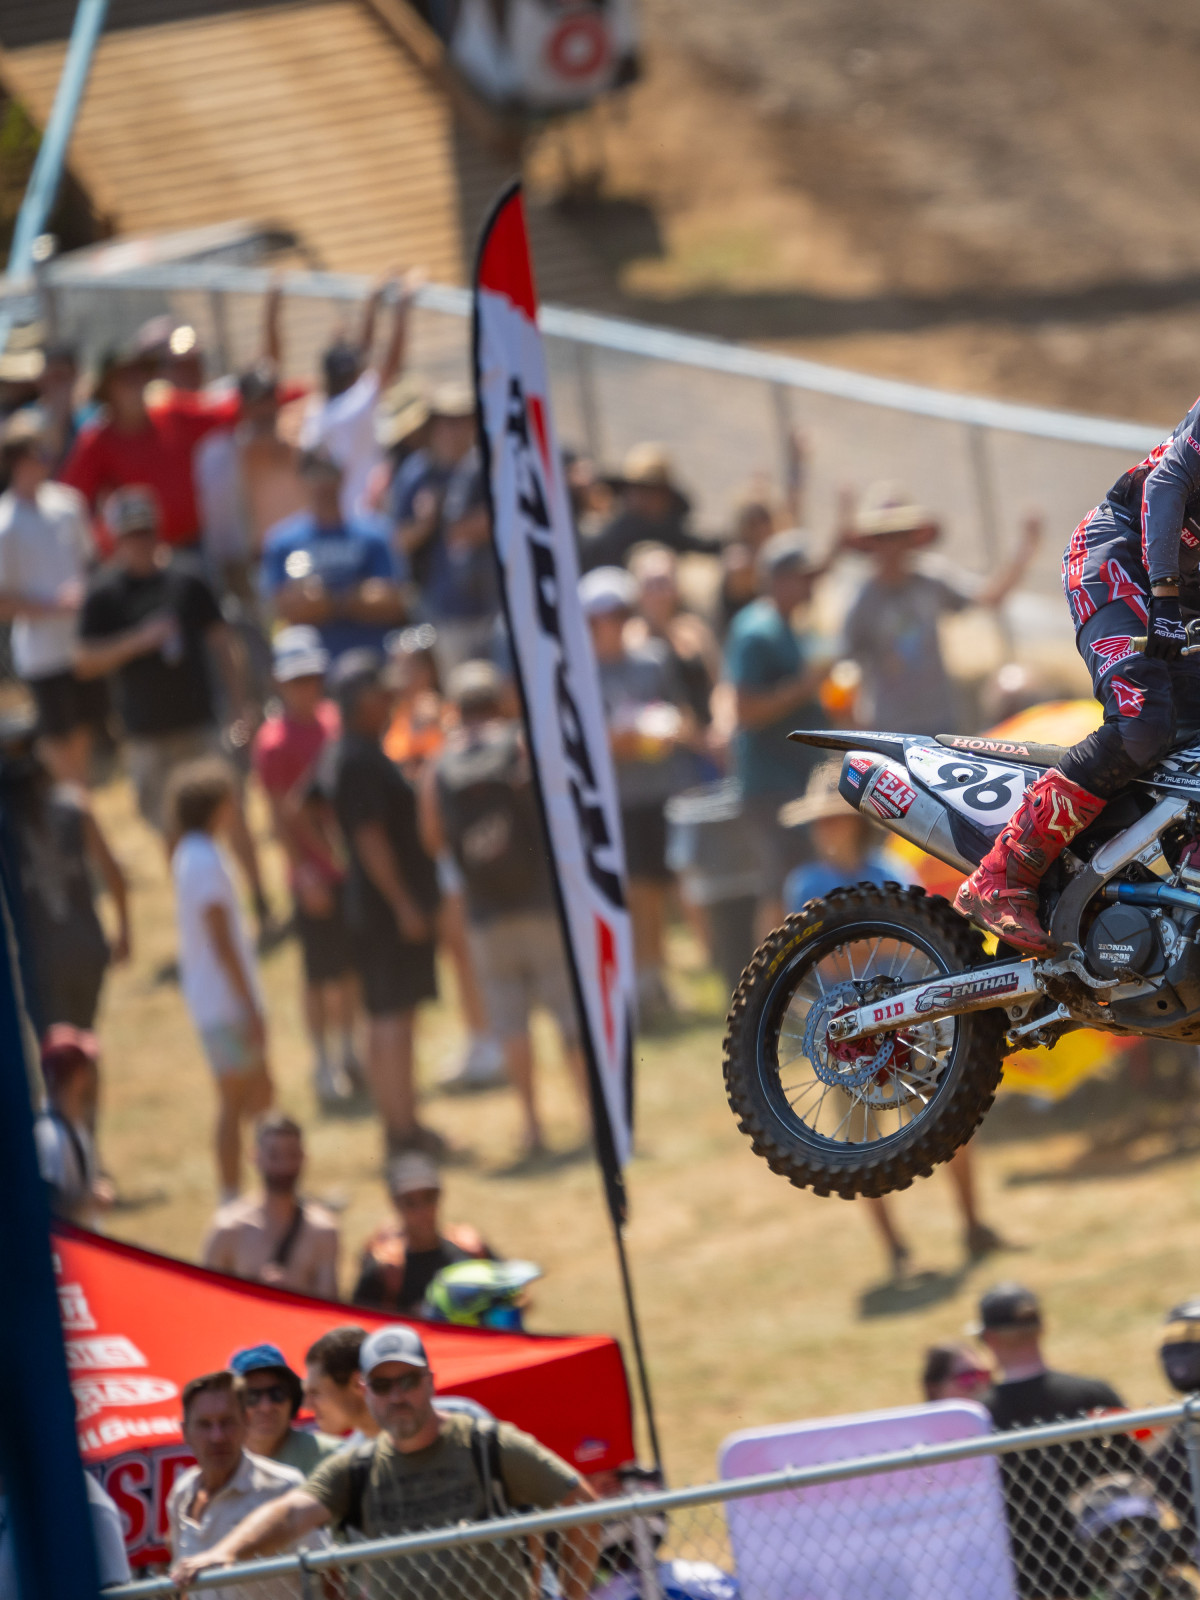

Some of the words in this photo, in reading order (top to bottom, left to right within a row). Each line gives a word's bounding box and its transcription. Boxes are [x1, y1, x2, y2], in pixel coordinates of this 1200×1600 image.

[1154, 629, 1187, 640] ASTARS
[1099, 649, 1140, 676] HONDA
[950, 738, 1030, 756] HONDA
[876, 772, 916, 810] ヨシムラ
[930, 762, 1020, 811] 96
